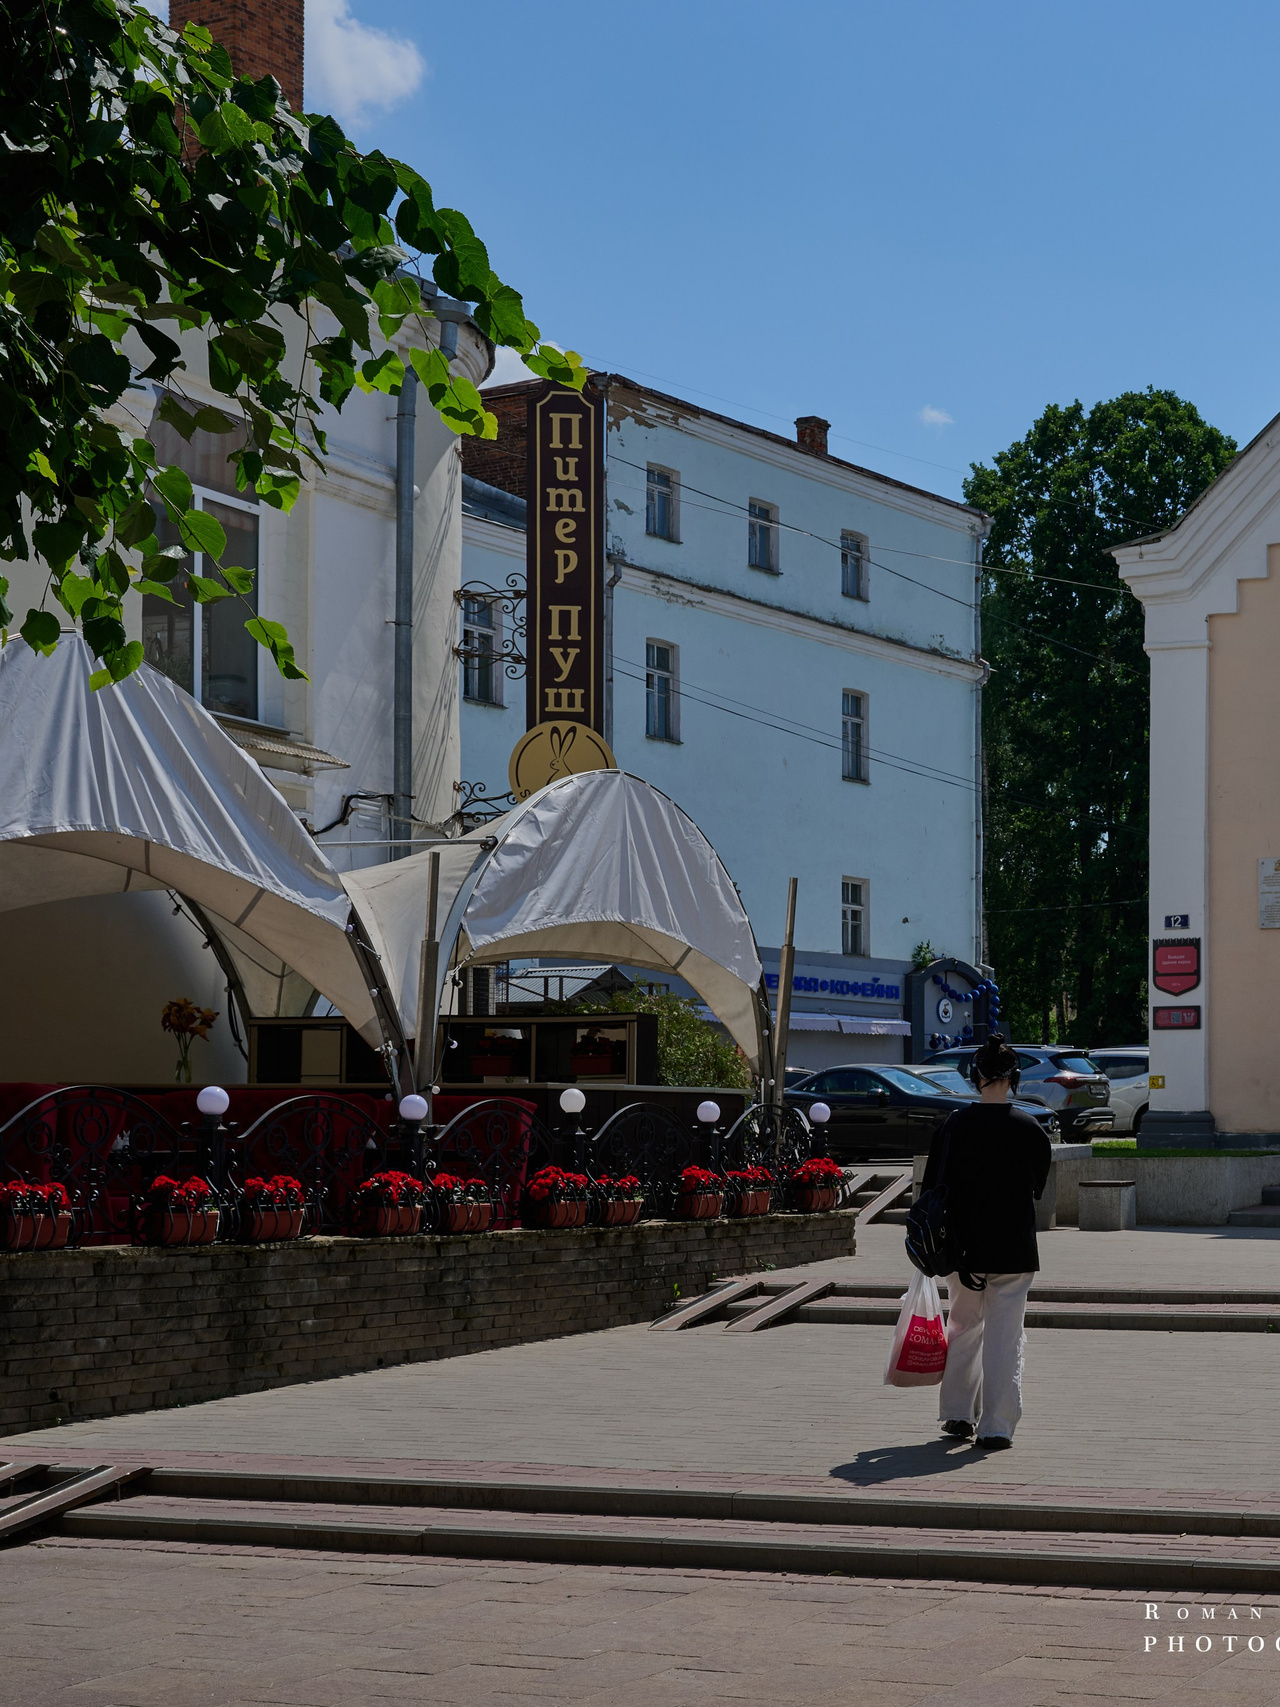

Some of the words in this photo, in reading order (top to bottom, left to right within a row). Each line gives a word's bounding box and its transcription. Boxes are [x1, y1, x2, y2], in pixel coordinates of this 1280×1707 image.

[546, 413, 586, 584] Питер
[545, 605, 585, 712] Пуш
[1171, 916, 1182, 927] 12
